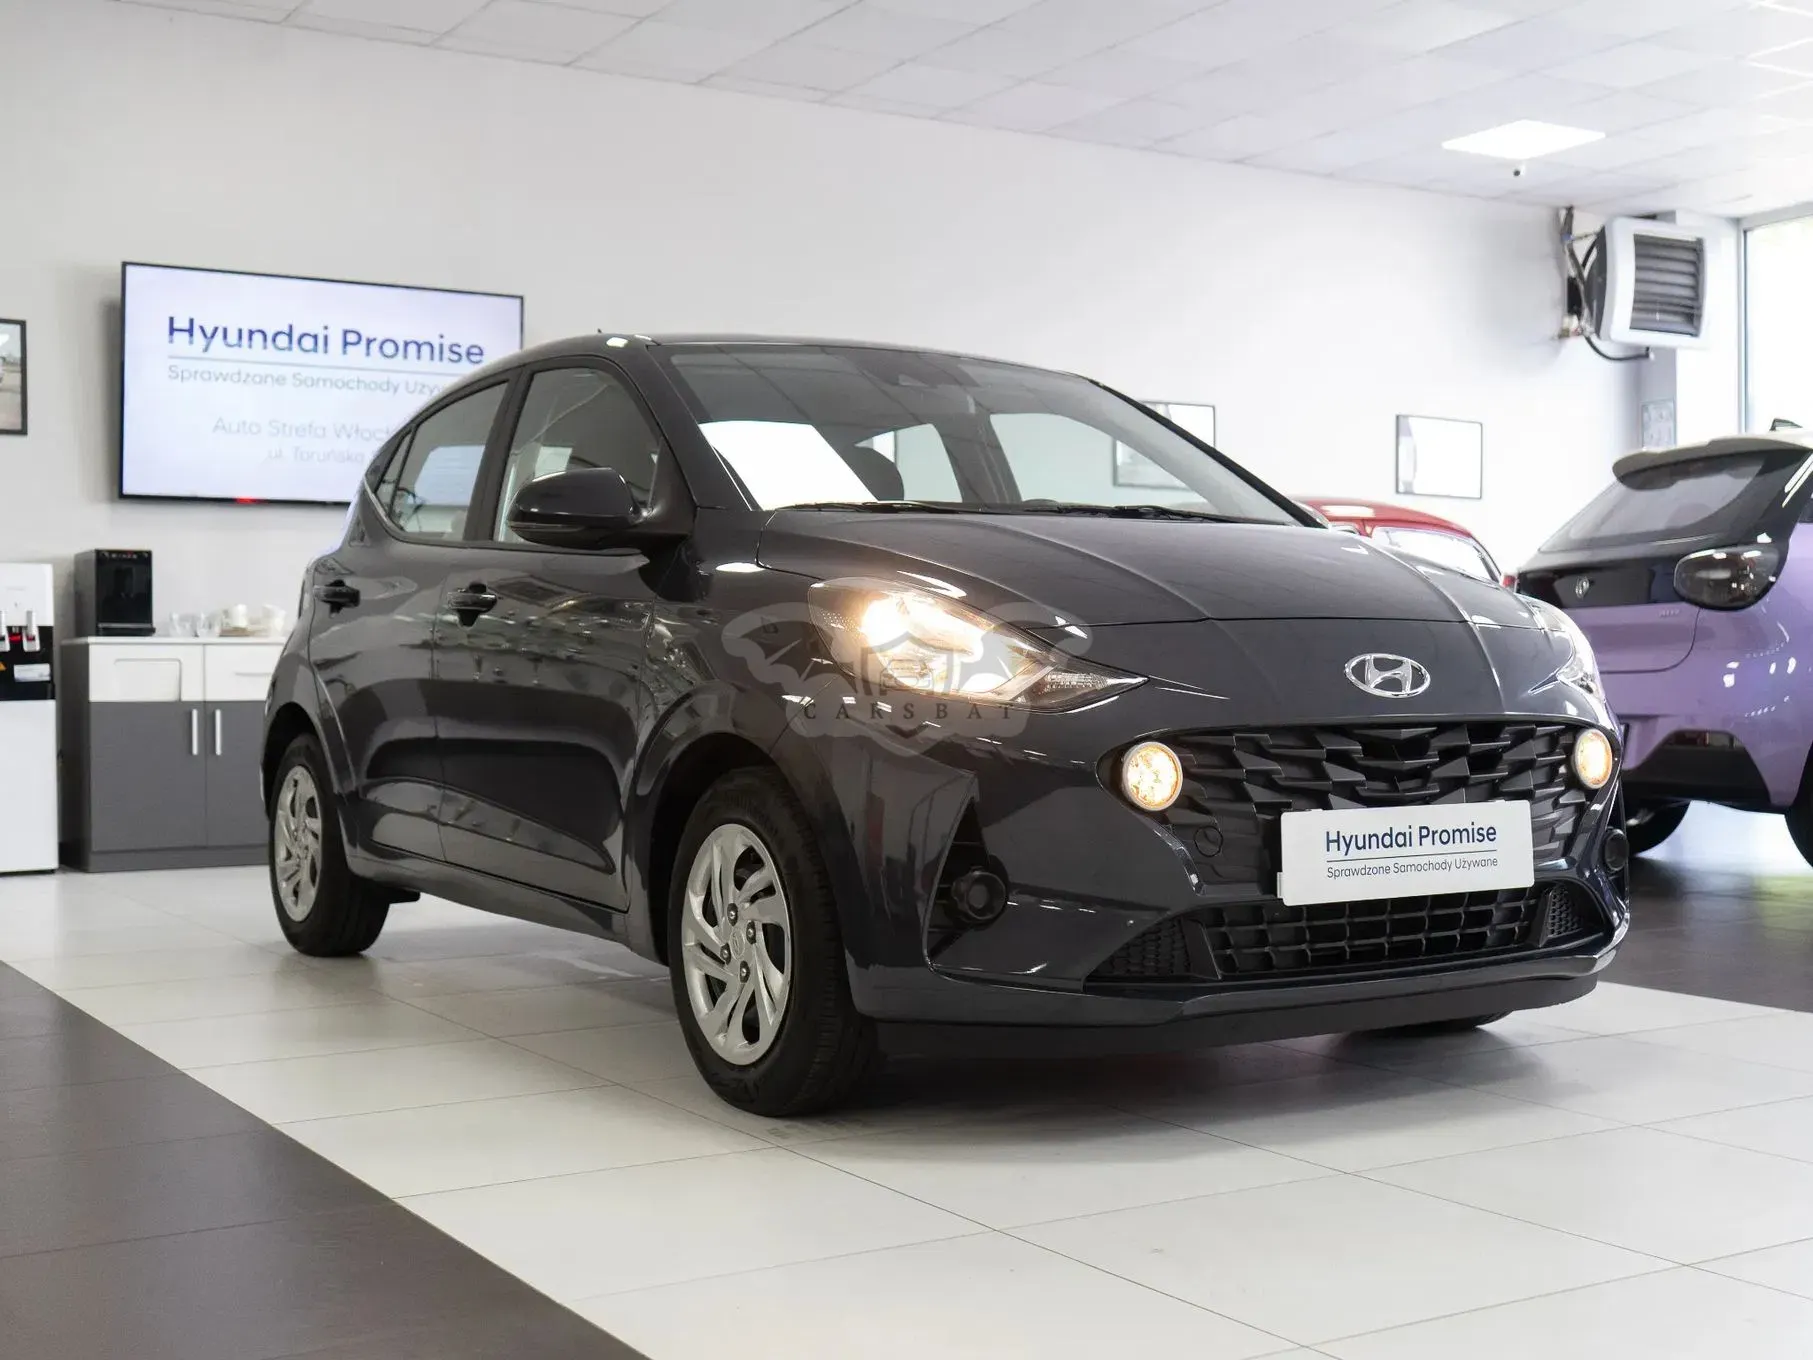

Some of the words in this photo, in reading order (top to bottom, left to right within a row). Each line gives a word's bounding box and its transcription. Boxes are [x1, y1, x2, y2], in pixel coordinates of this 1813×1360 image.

[168, 315, 330, 355] Hyundai
[342, 328, 484, 365] Promise
[292, 372, 399, 396] Samochody
[212, 416, 262, 436] Auto
[268, 419, 326, 439] Strefa
[1326, 825, 1413, 856] Hyundai
[1419, 821, 1497, 847] Promise
[1327, 864, 1391, 880] Sprawdzone
[1393, 859, 1453, 875] Samochody
[1454, 856, 1498, 871] Używane
